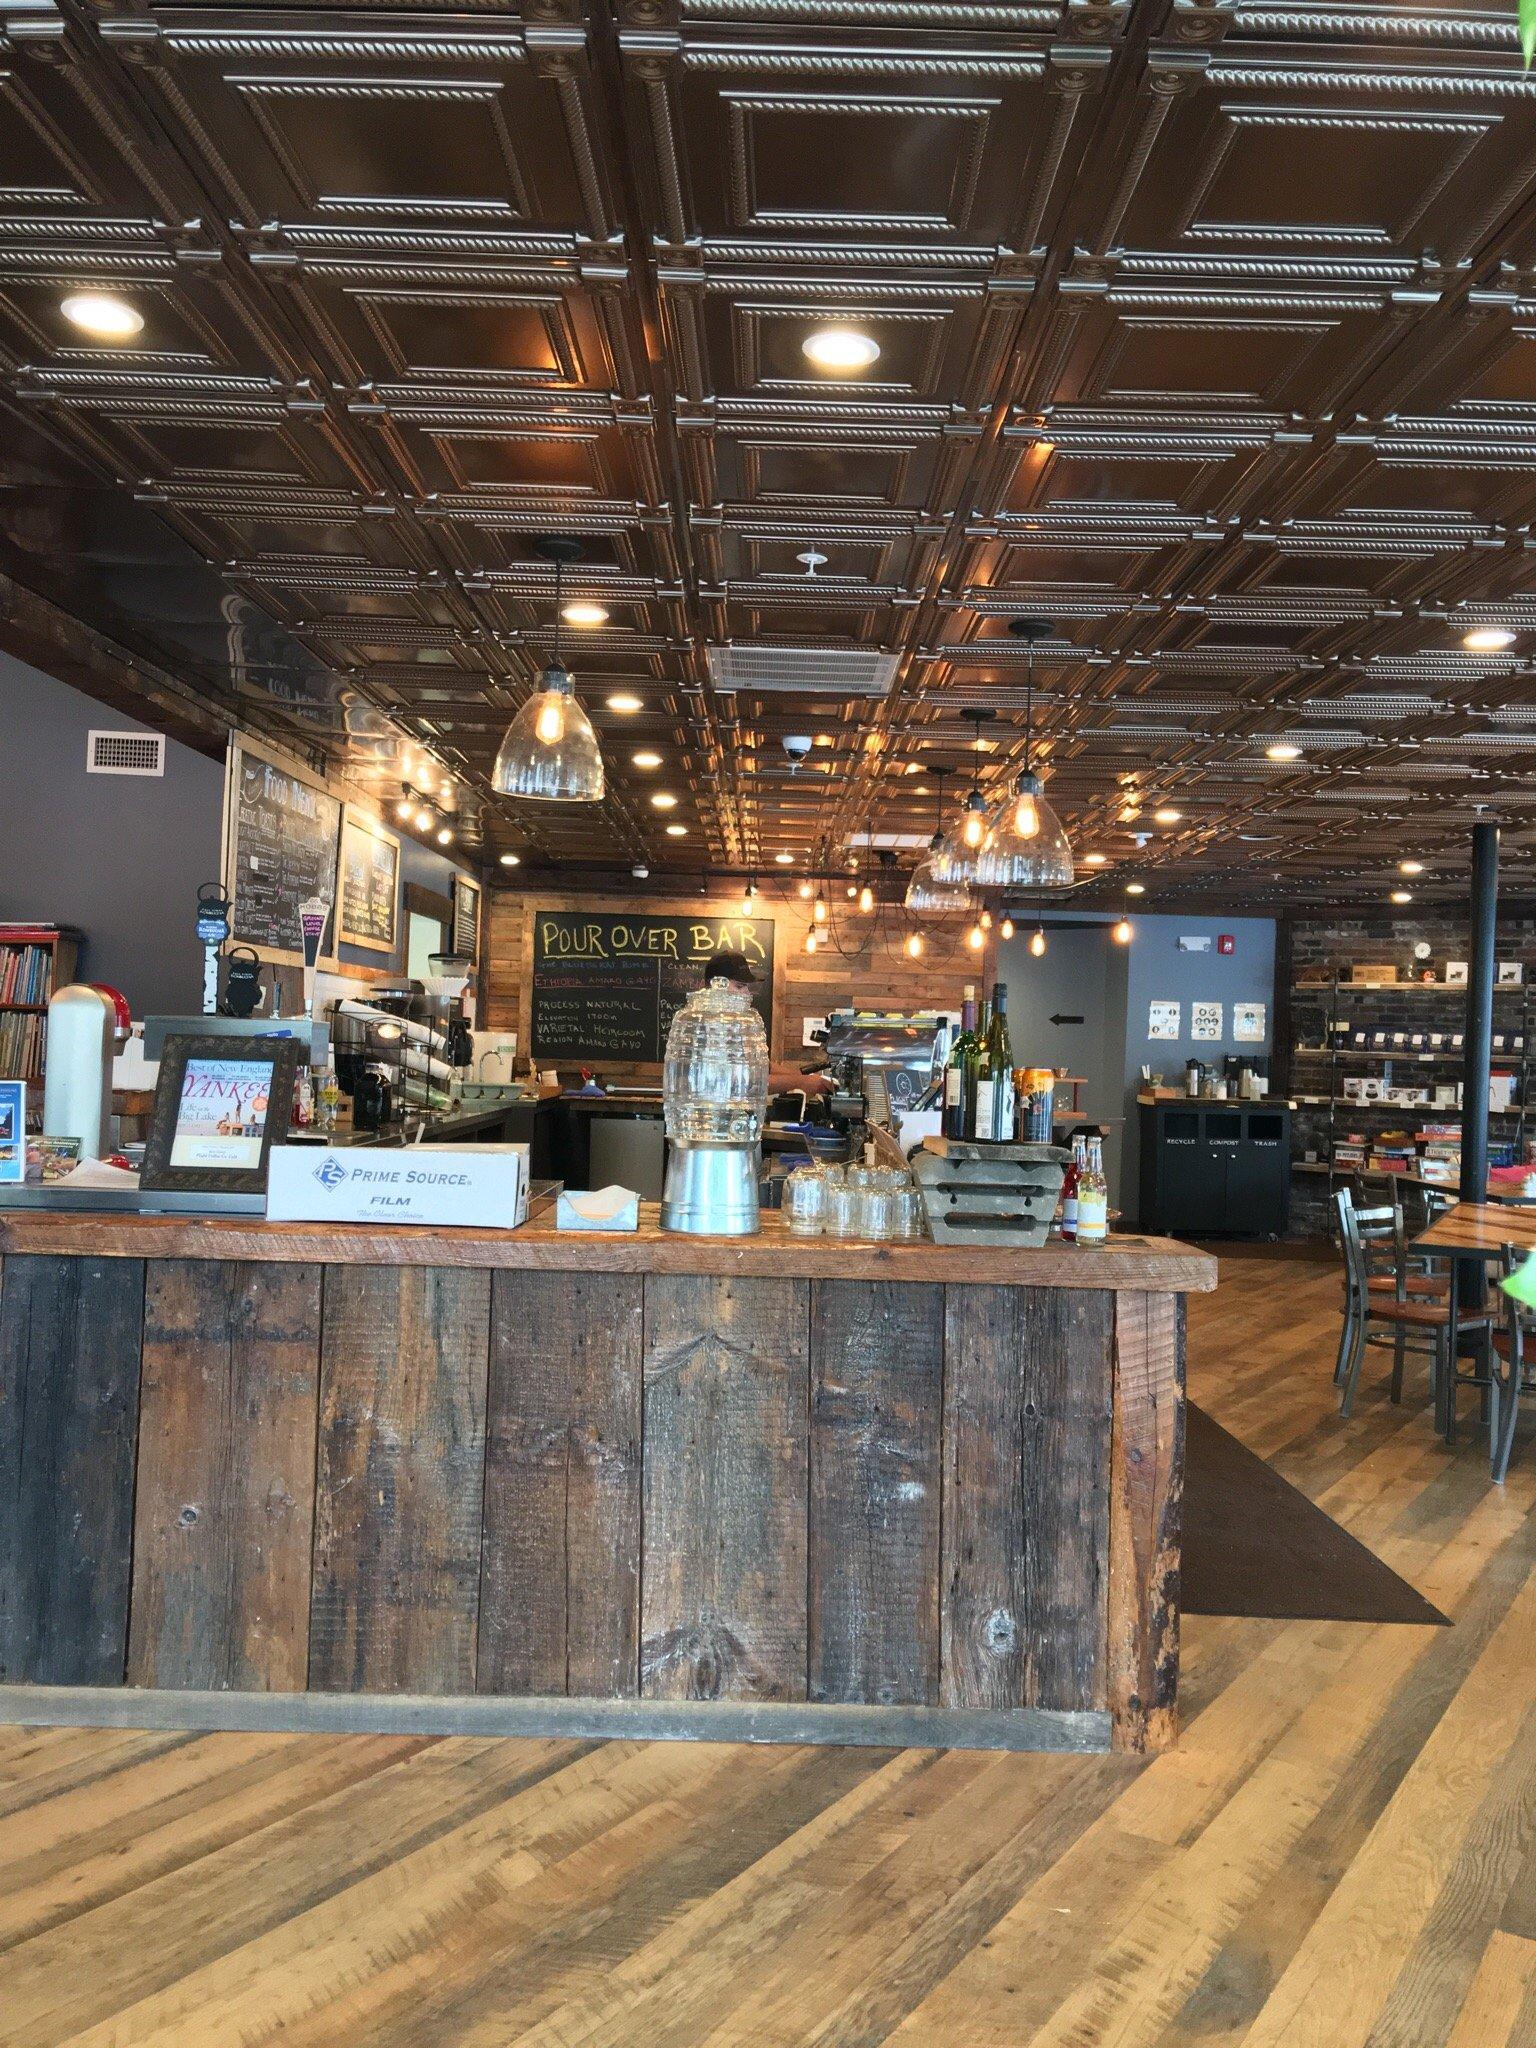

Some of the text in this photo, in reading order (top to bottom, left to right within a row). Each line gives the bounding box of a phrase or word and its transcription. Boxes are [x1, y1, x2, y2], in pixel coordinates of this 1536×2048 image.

[542, 922, 765, 960] POUR OVER BAR
[538, 1000, 642, 1011] PROCESS NATURAL
[536, 1022, 585, 1034] VARIETAL
[187, 1062, 206, 1072] Best
[208, 1063, 216, 1073] of
[219, 1063, 237, 1073] New
[181, 1074, 272, 1104] YANKEE
[351, 1168, 401, 1184] PRIME
[370, 1196, 412, 1206] FILM
